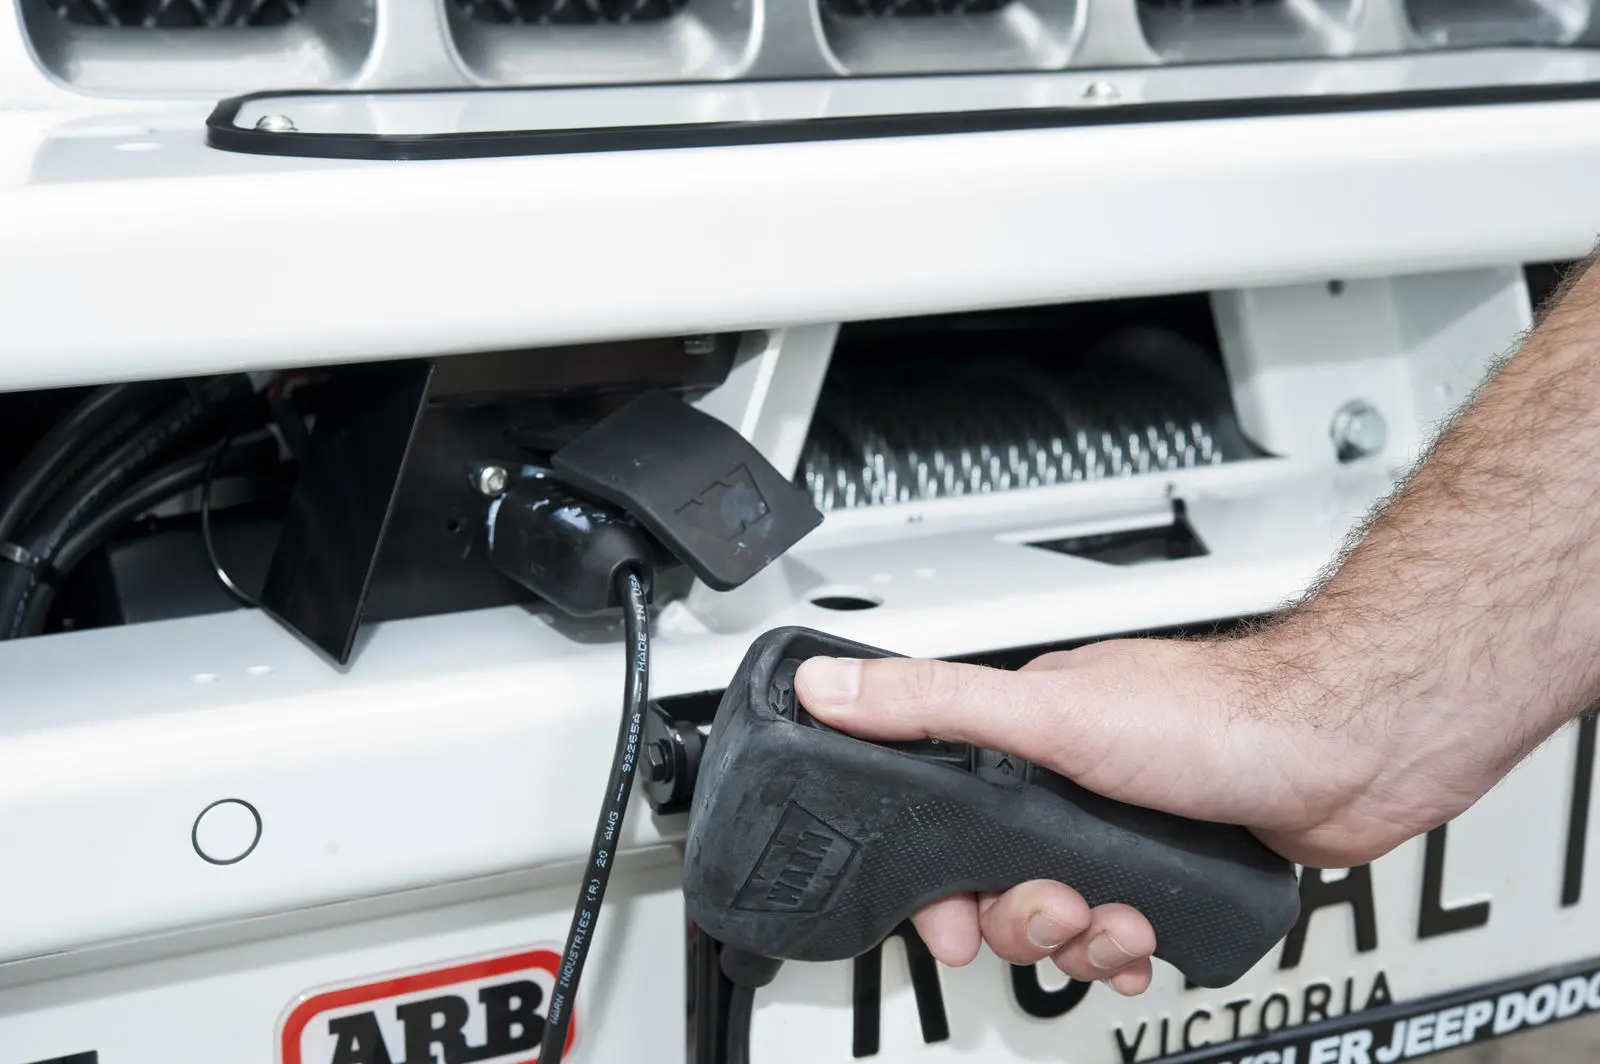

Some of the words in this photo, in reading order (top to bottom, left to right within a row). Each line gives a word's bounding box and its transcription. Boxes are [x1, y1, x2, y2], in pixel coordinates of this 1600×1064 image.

[636, 603, 646, 622] IN
[637, 631, 647, 672] MADE
[603, 810, 619, 841] AWG
[595, 850, 609, 868] 20
[587, 878, 601, 902] (R)
[559, 909, 592, 989] INDUSTRIES
[328, 979, 549, 1064] ARB
[550, 994, 565, 1026] WARN
[1113, 969, 1395, 1064] VICTORIA
[1373, 1000, 1494, 1063] JEEP
